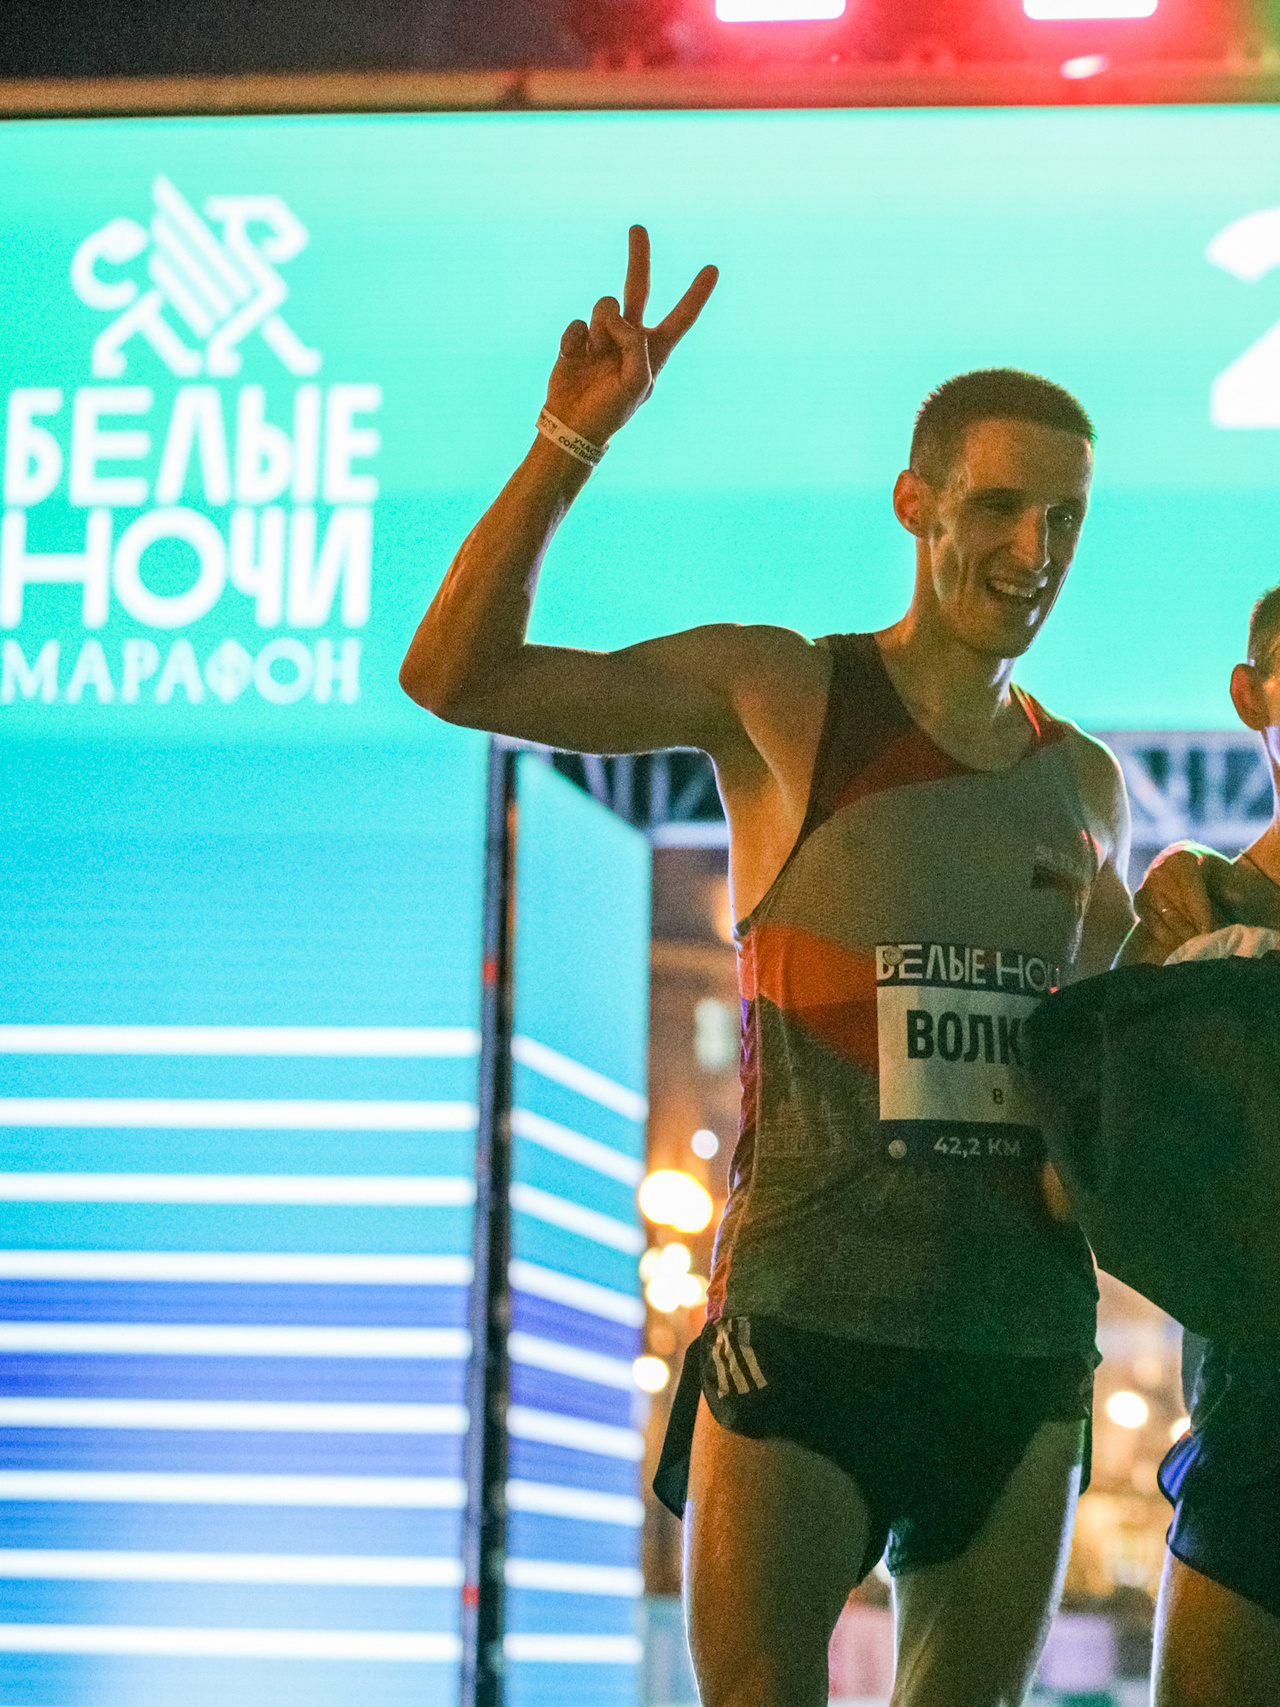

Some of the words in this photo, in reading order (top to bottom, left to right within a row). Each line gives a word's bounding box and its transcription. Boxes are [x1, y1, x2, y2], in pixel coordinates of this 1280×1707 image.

[4, 384, 382, 506] БЕЛЫЕ
[0, 506, 374, 629] НОЧИ
[0, 637, 362, 704] МАРАФОН
[876, 943, 987, 985] БЕЛЫЕ
[933, 1136, 981, 1158] 42,2
[987, 1138, 1021, 1157] КМ
